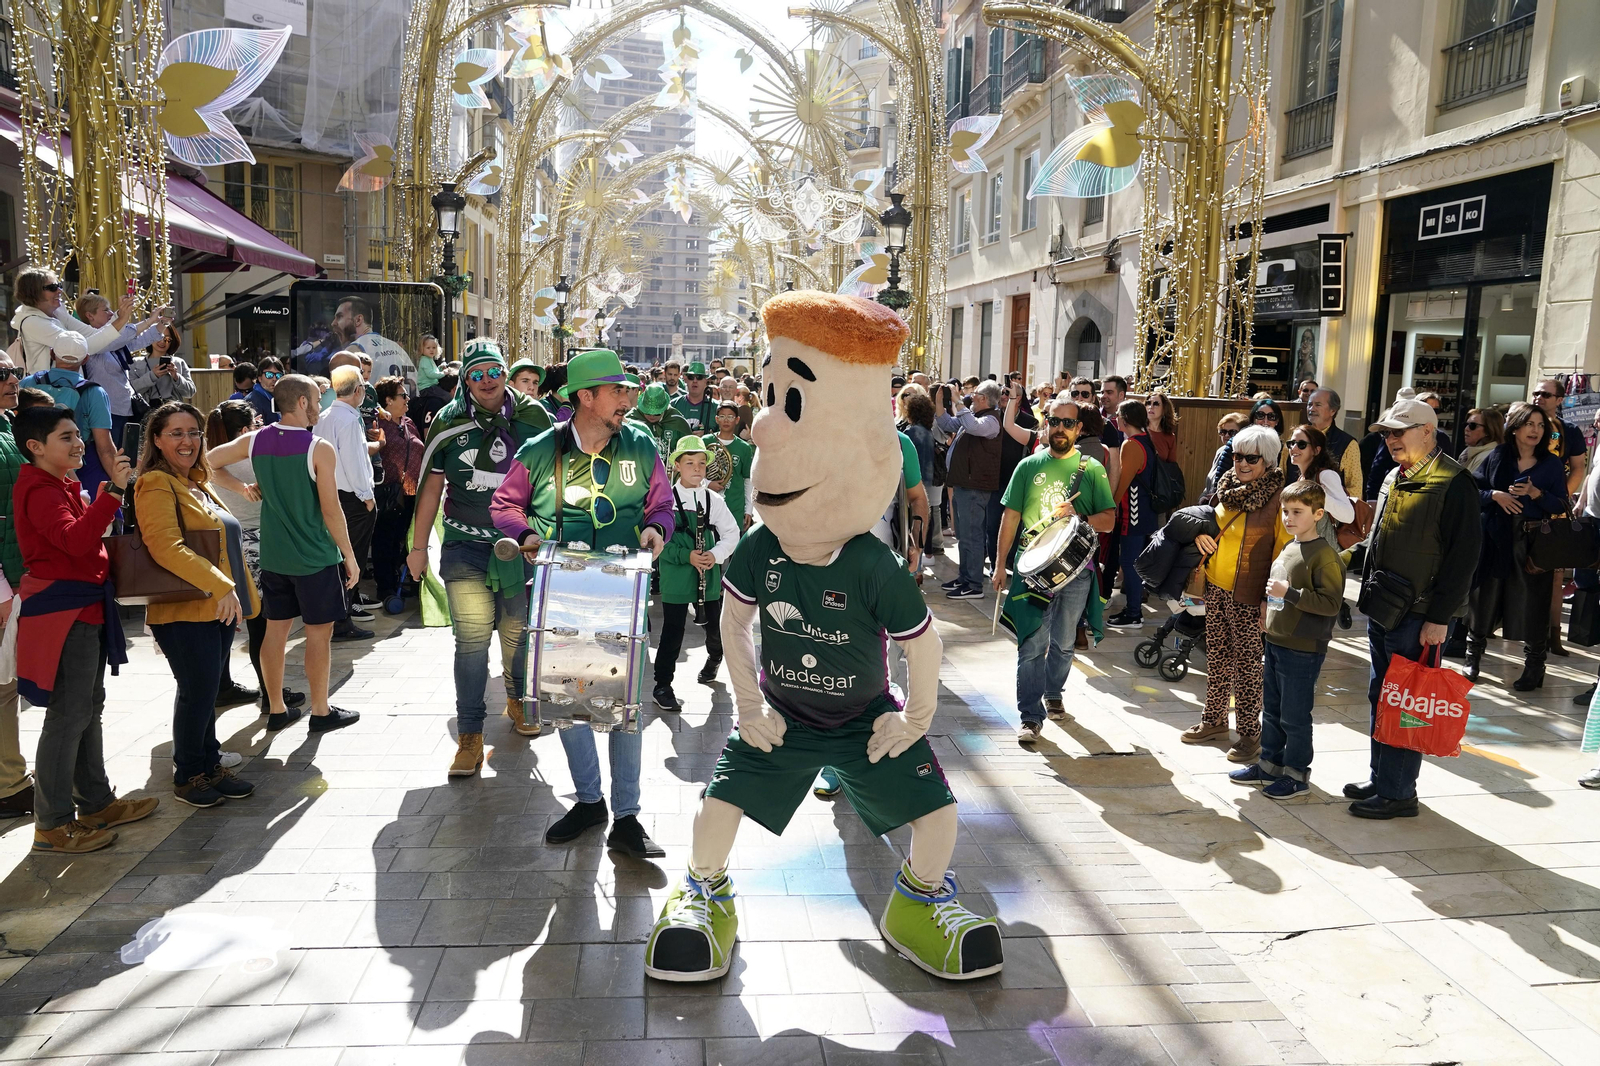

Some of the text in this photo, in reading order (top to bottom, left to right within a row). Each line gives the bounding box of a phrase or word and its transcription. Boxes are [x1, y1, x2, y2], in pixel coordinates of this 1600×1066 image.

[1426, 209, 1478, 227] MI SA KO
[253, 306, 281, 315] Massimo
[424, 411, 432, 424] 6
[618, 460, 638, 487] U
[802, 621, 849, 643] Unicaja
[770, 659, 857, 691] Madegar
[1382, 678, 1400, 691] Las
[1380, 688, 1464, 719] rebajas
